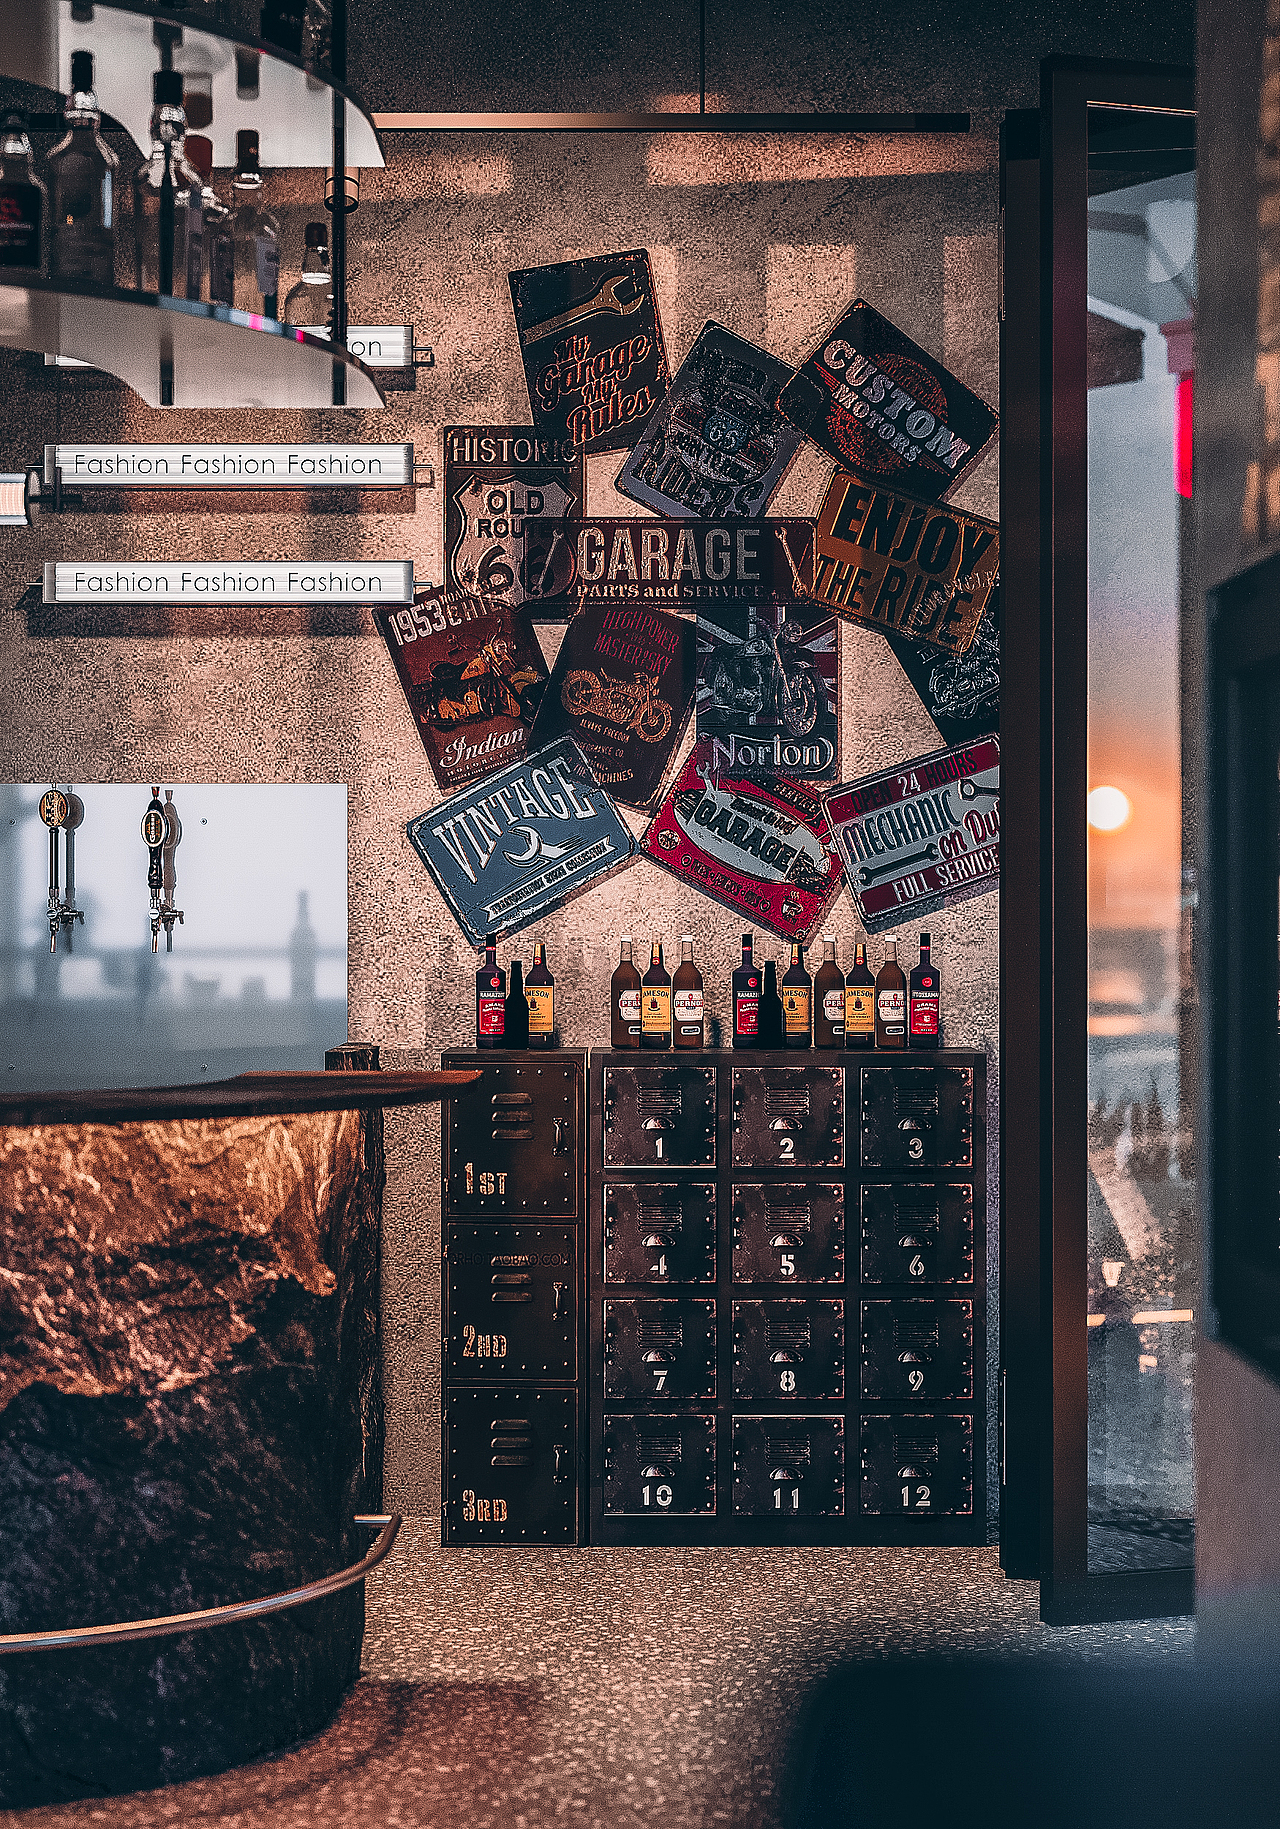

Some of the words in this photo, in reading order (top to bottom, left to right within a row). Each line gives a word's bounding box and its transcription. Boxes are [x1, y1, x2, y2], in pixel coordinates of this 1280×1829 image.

[554, 334, 592, 365] My
[536, 334, 653, 412] Garage
[567, 385, 657, 447] Rules
[823, 339, 971, 470] CUSTOM
[831, 383, 922, 462] MOTORS
[74, 455, 168, 475] Fashion
[181, 455, 275, 475] Fashion
[287, 455, 382, 475] Fashion
[453, 438, 578, 463] HISTORIC
[485, 489, 545, 515] OLD
[830, 481, 996, 580] ENJOY
[577, 526, 761, 581] GARAGE
[74, 572, 168, 592] Fashion
[181, 572, 275, 592] Fashion
[287, 572, 382, 592] Fashion
[577, 584, 639, 598] PARTS
[643, 583, 679, 598] and
[683, 584, 764, 598] SERVICE
[810, 553, 873, 610] THE
[870, 563, 974, 648] RIDE
[388, 598, 447, 646] 1953
[439, 727, 525, 768] Indian
[712, 733, 834, 774] Norton
[850, 781, 894, 813] OPEN
[897, 772, 921, 797] 24
[923, 750, 978, 788] HOURS
[431, 756, 598, 885] VINTAGE
[694, 798, 800, 872] GARAGE
[841, 789, 962, 865] MECHANIC
[891, 874, 934, 903] FULL
[935, 844, 1000, 887] SERVICE
[655, 1137, 663, 1158] 1
[779, 1137, 795, 1159] 2
[908, 1137, 923, 1159] 3
[465, 1162, 508, 1195] 1ST
[650, 1254, 667, 1275] 4
[780, 1254, 795, 1276] 5
[909, 1254, 925, 1276] 6
[462, 1324, 507, 1358] 2ND
[653, 1370, 668, 1391] 7
[779, 1370, 796, 1391] 8
[908, 1370, 924, 1391] 9
[462, 1489, 508, 1522] 3RD
[642, 1485, 673, 1506] 10
[773, 1487, 799, 1509] 11
[901, 1485, 931, 1507] 12
